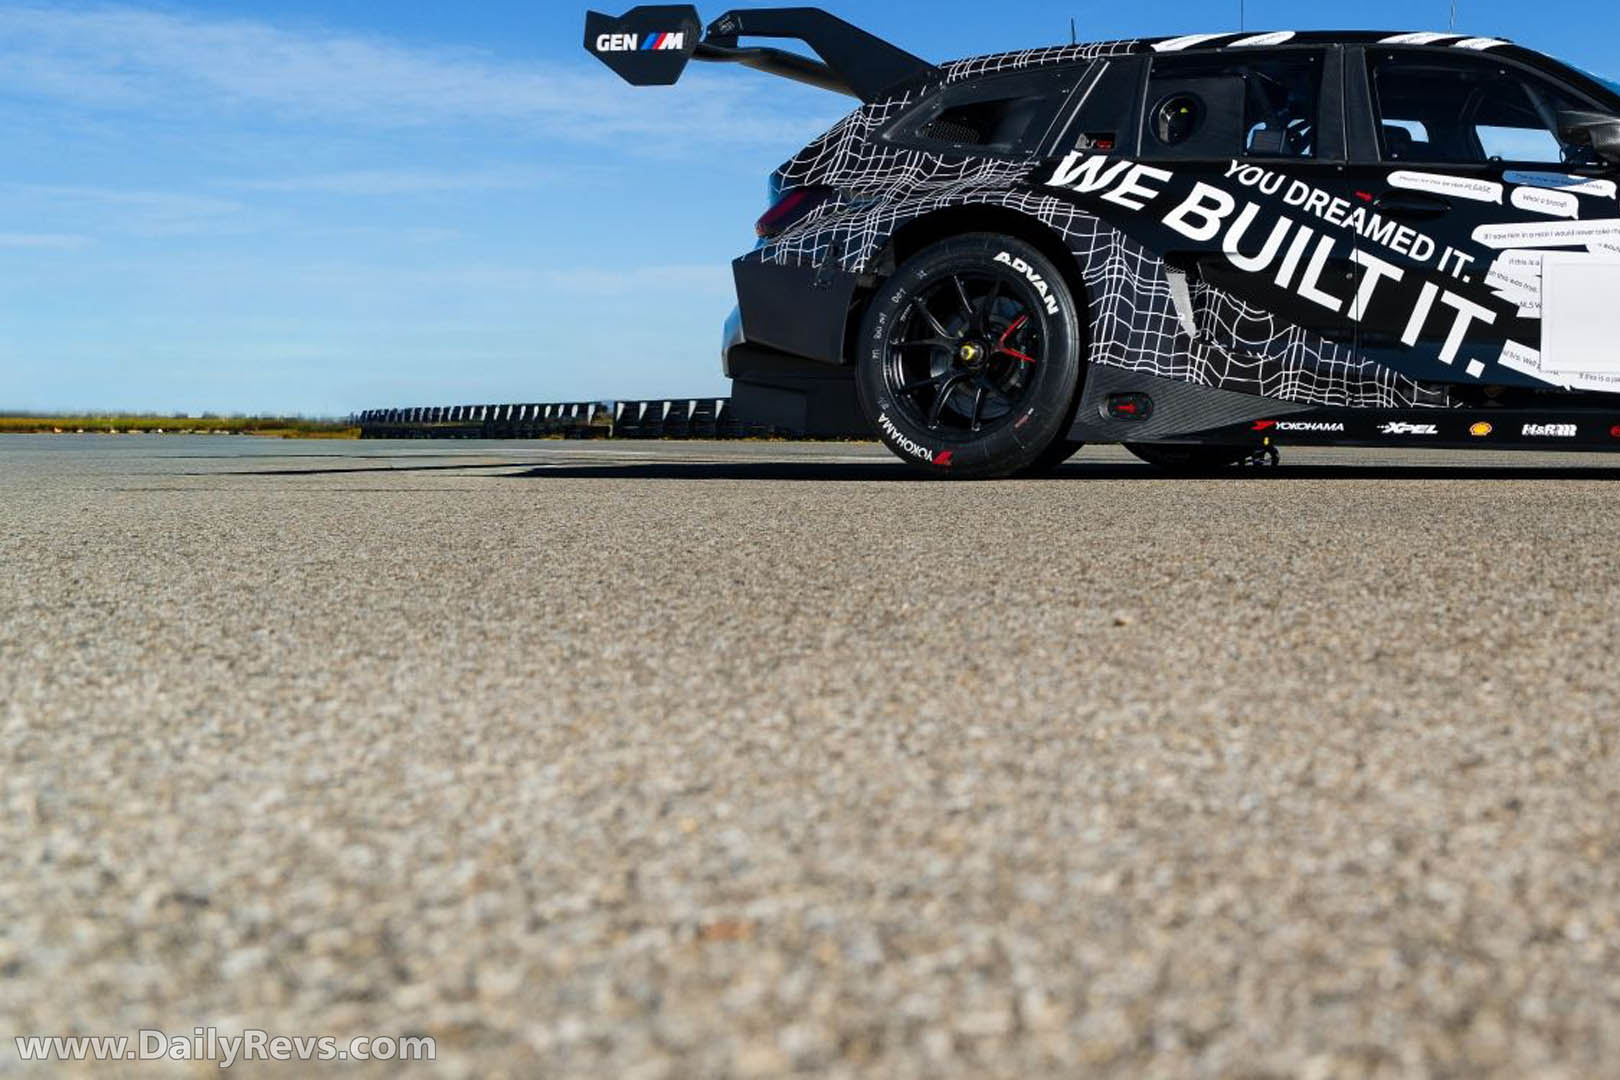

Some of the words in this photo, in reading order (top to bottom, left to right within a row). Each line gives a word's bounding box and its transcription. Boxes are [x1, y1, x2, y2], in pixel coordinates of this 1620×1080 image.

[596, 33, 638, 51] GEN
[1224, 159, 1286, 195] YOU
[1284, 180, 1435, 262] DREAMED
[1437, 246, 1475, 283] IT.
[993, 251, 1060, 315] ADVAN
[1045, 150, 1173, 211] WE
[1161, 181, 1405, 322] BUILT
[1400, 281, 1497, 378] IT.
[877, 412, 933, 462] YOKOHAMA
[1275, 422, 1345, 432] YOKOHAMA
[1382, 421, 1439, 435] XPEL
